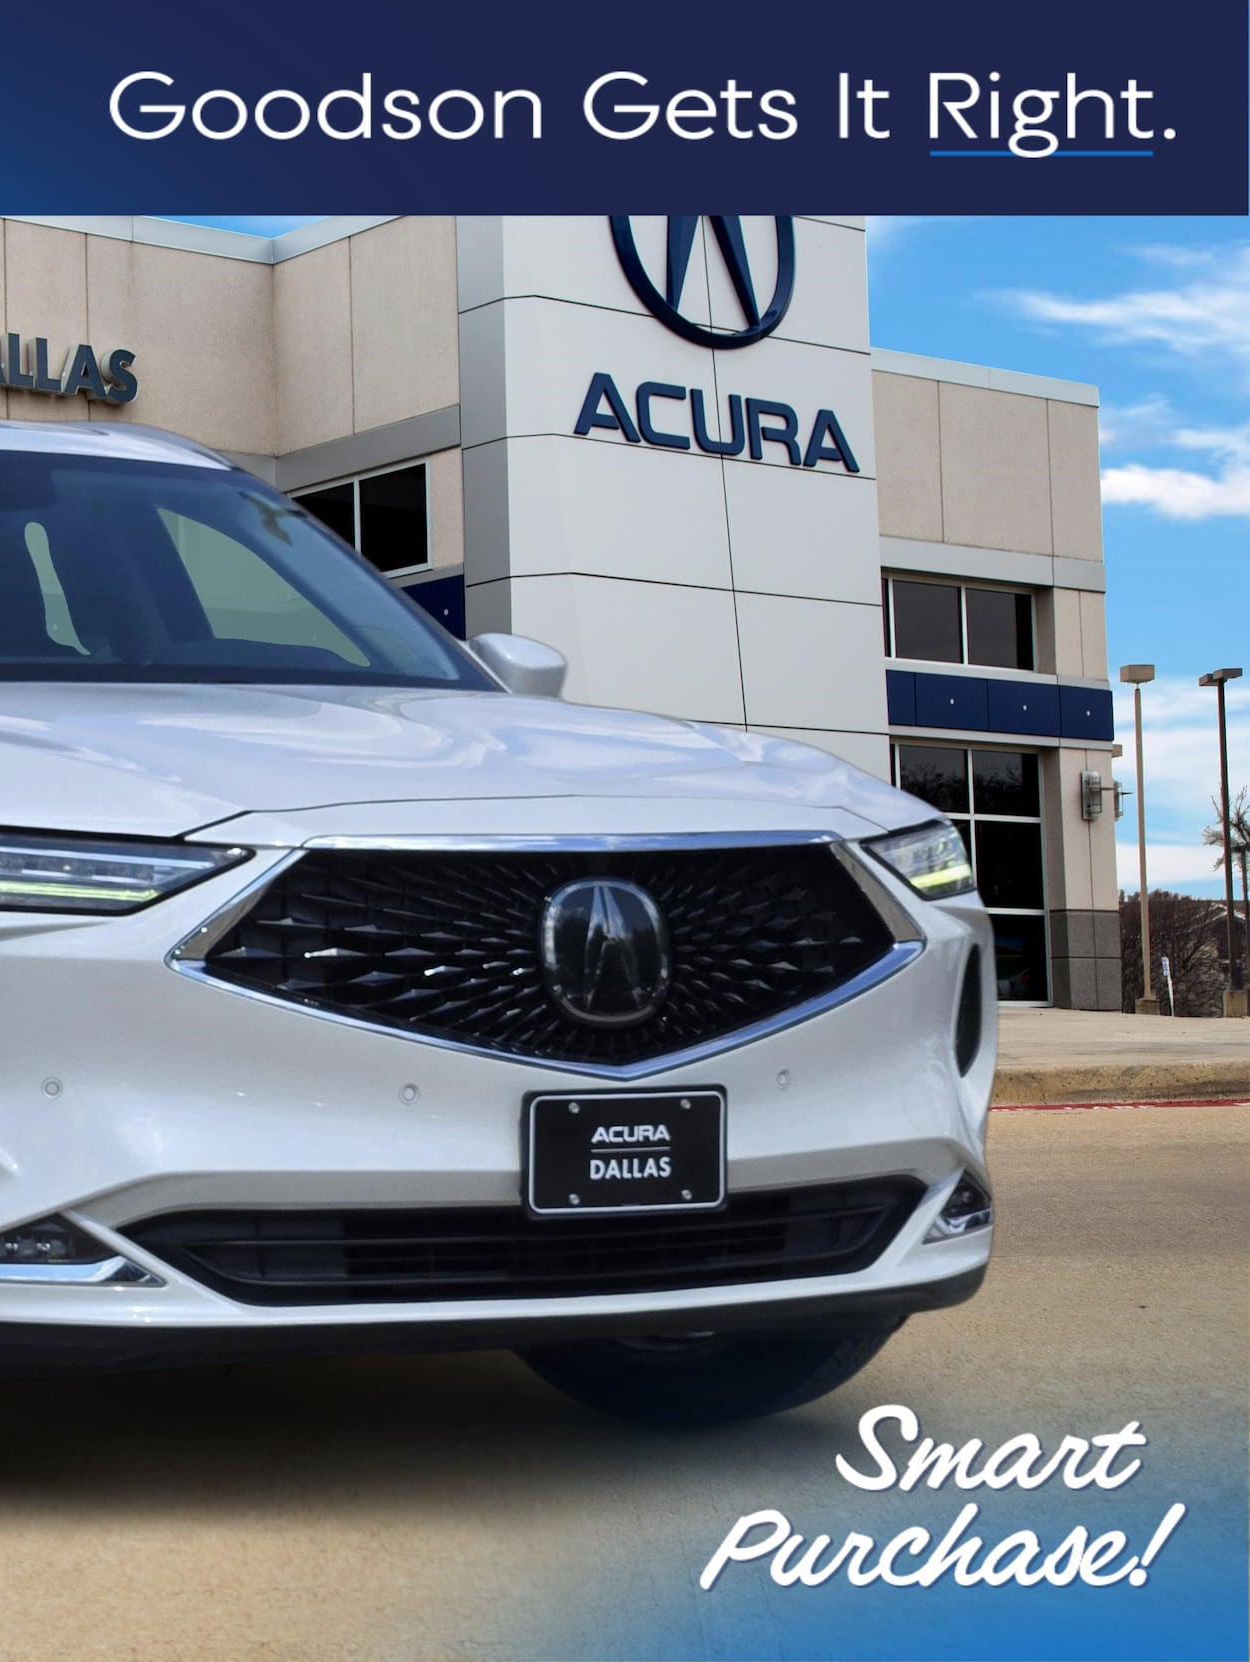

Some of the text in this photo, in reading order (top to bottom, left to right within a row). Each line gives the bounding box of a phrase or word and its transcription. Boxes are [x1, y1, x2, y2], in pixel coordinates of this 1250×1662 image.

[573, 372, 860, 473] ACURA
[590, 1124, 671, 1144] ACURA
[589, 1156, 672, 1180] DALLAS
